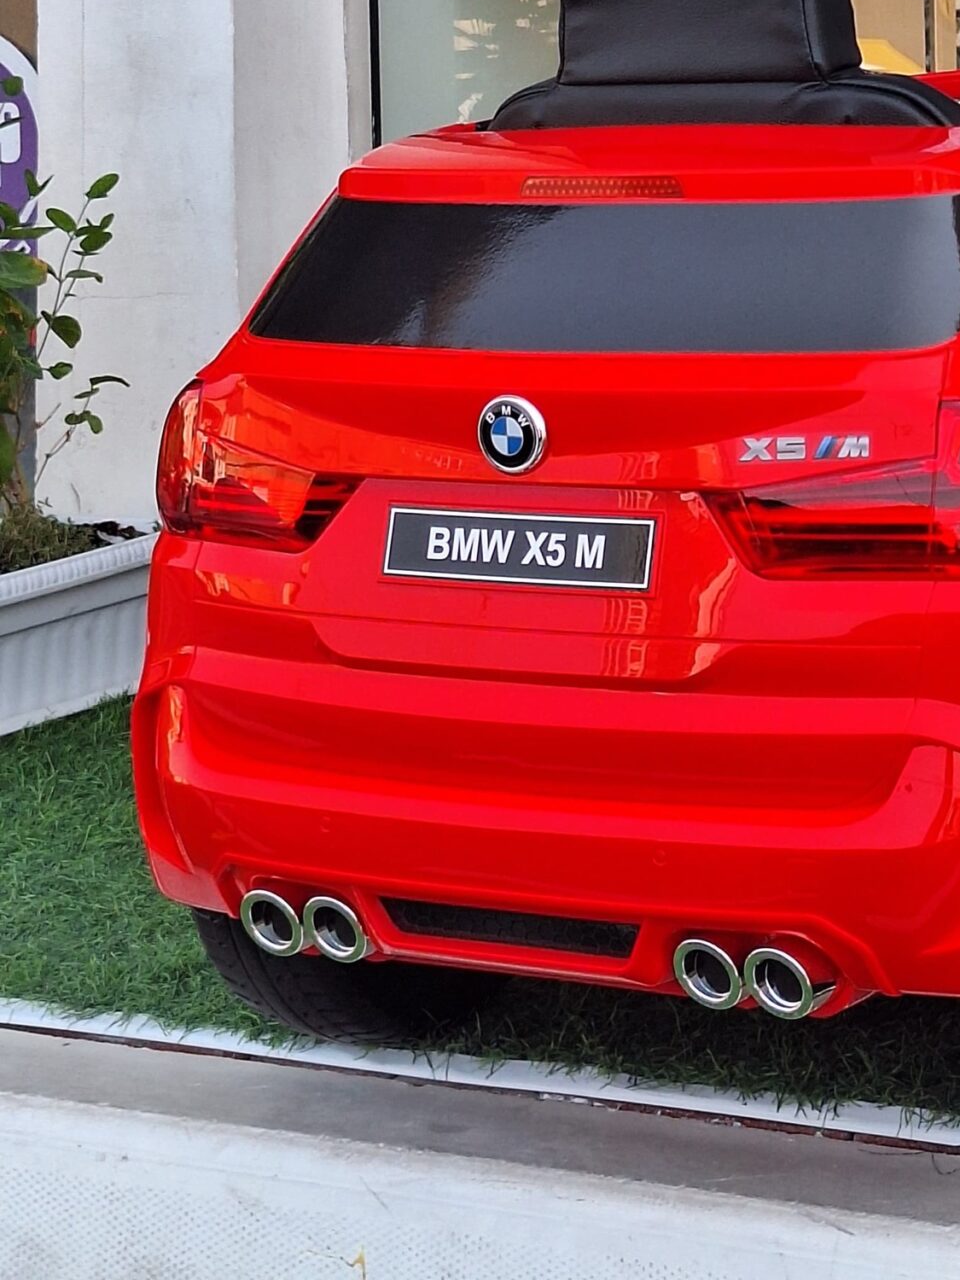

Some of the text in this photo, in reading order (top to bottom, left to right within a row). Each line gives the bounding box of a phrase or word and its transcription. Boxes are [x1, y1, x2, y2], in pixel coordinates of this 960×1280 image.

[485, 405, 531, 427] BMW
[738, 436, 806, 462] X5
[426, 525, 607, 570] BMW X5 M
